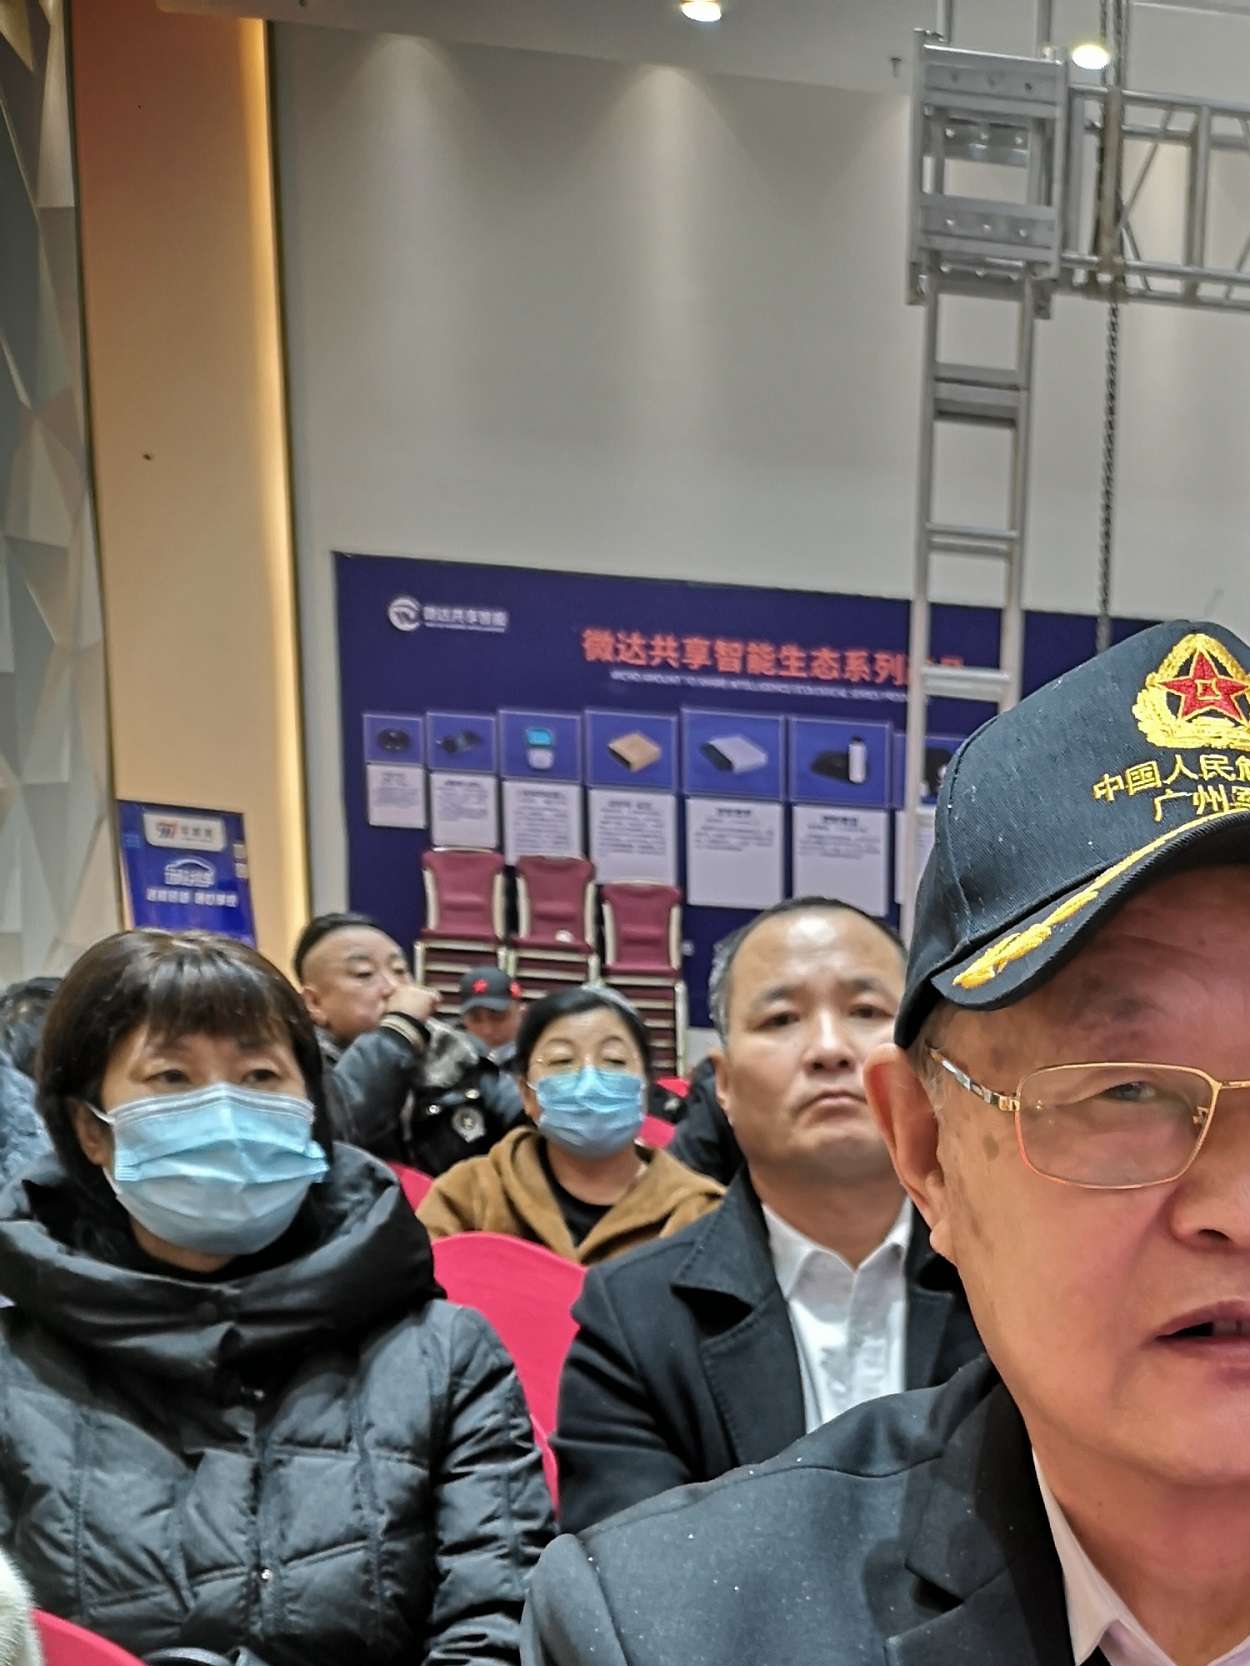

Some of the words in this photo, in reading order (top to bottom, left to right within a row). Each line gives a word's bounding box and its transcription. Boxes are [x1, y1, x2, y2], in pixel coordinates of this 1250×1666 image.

[582, 627, 964, 686] 微达共享智能生态系列
